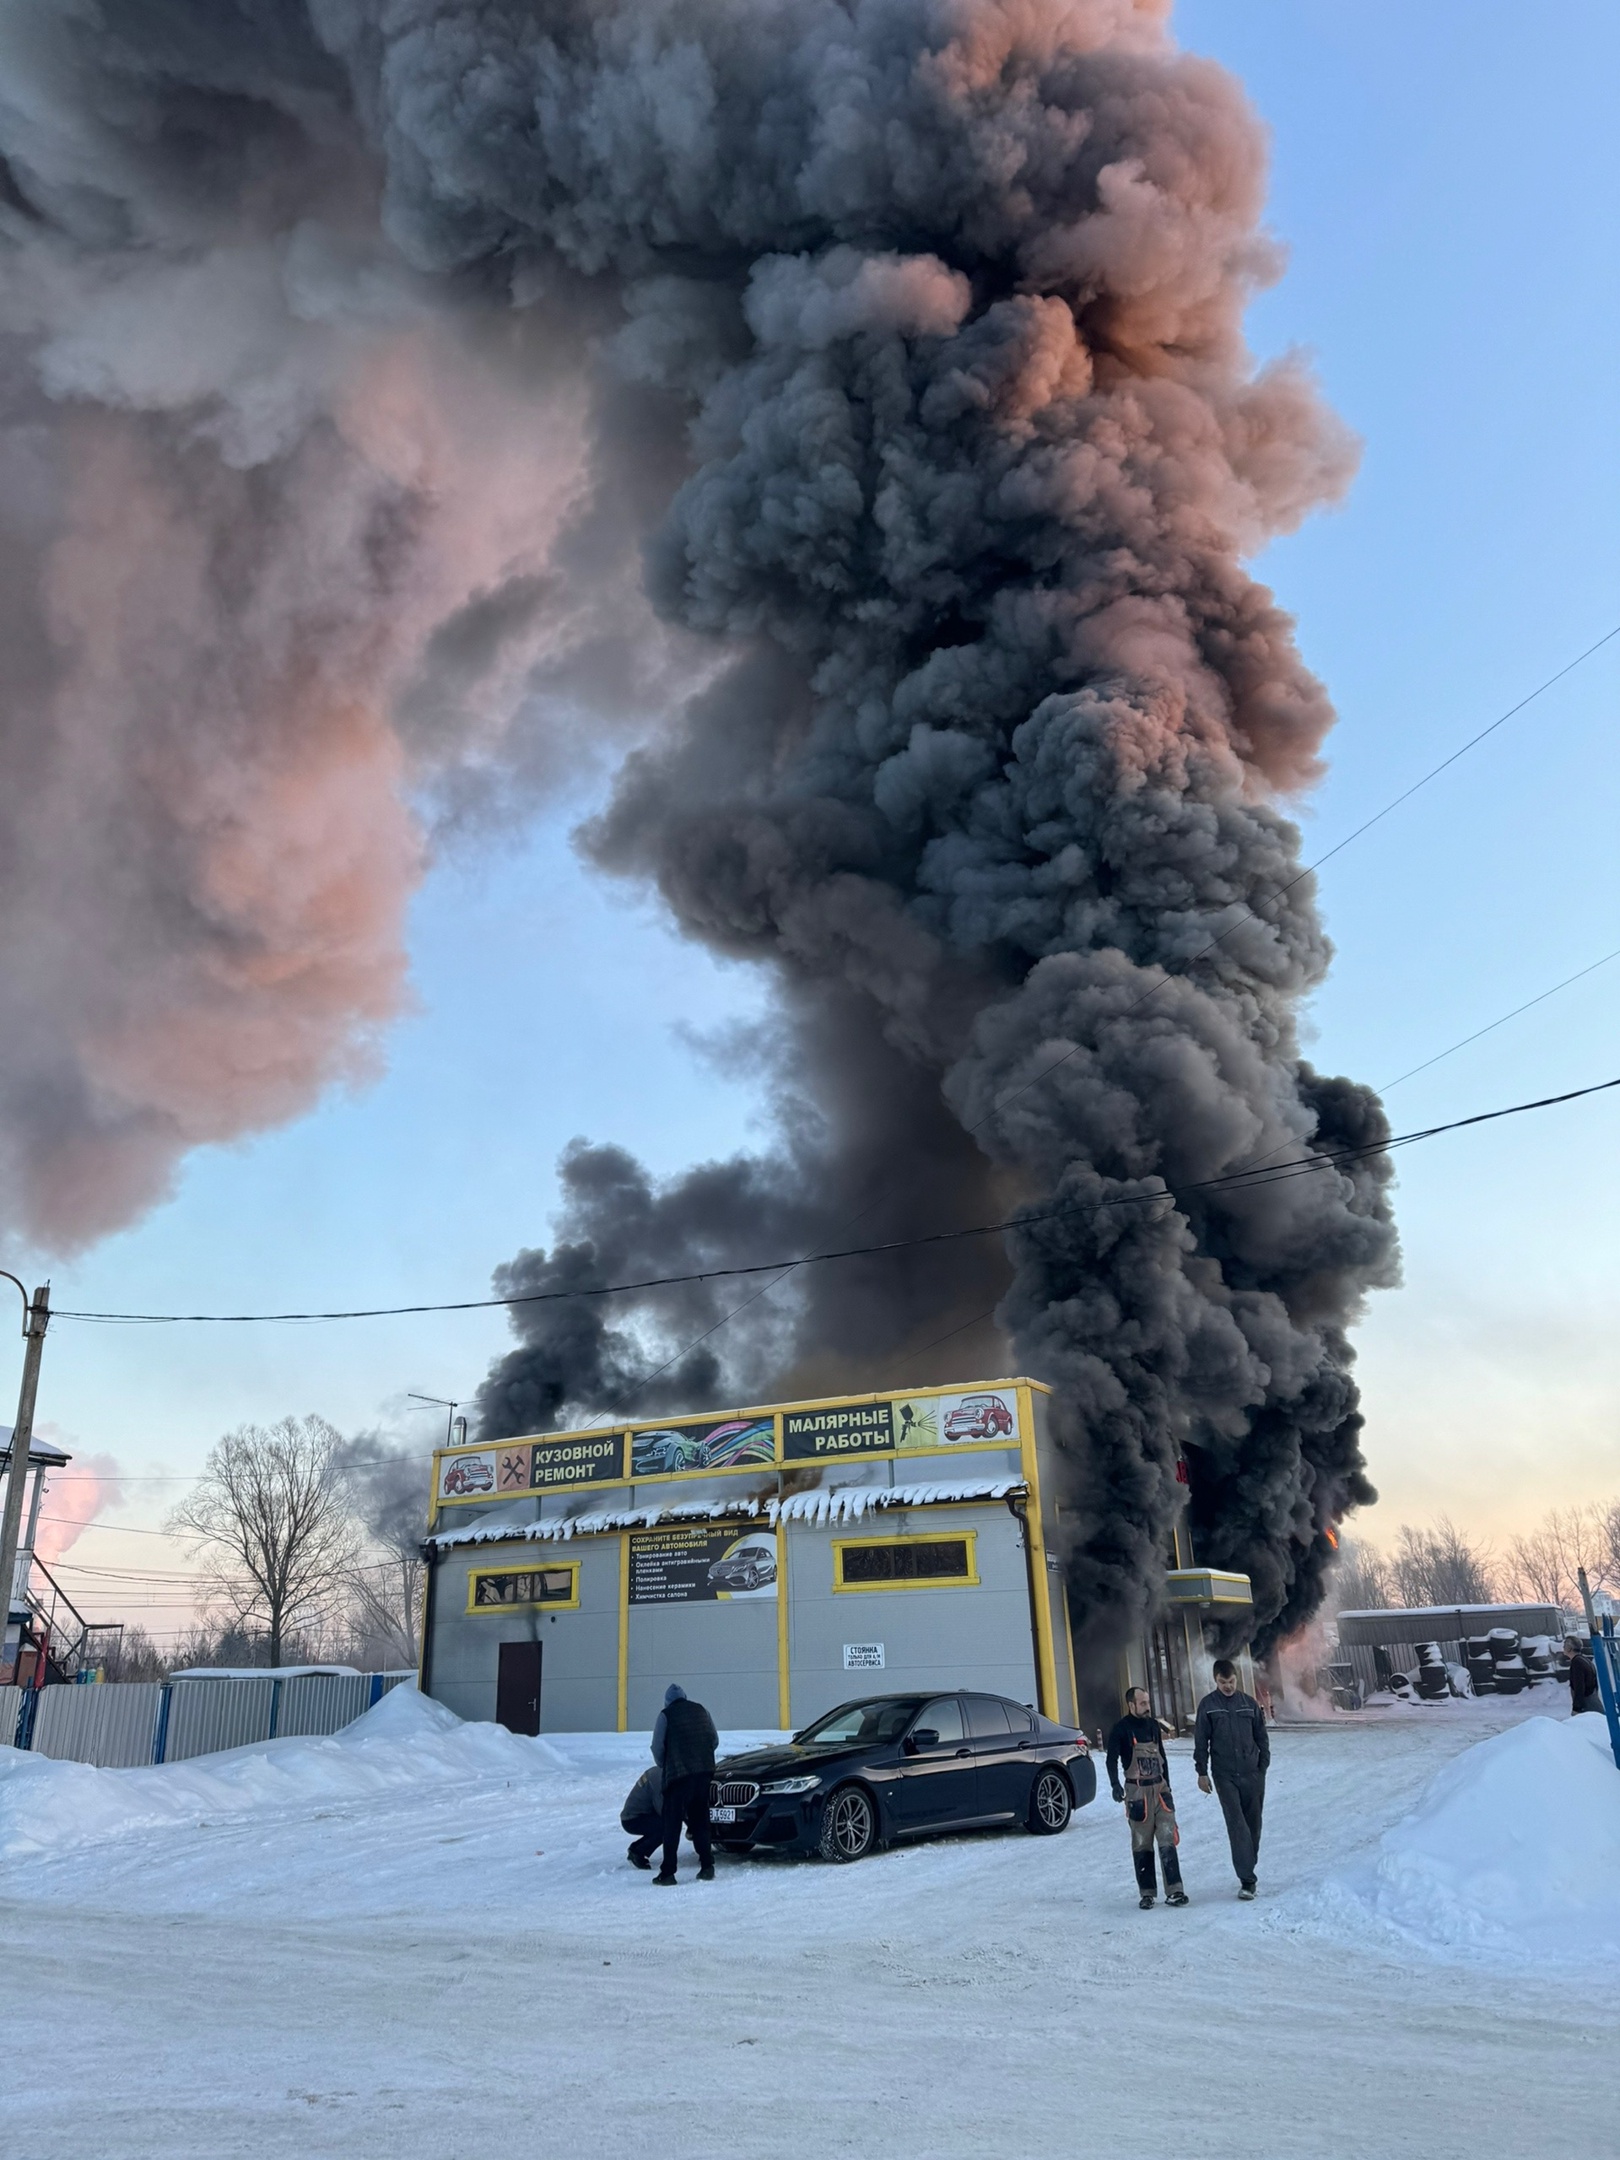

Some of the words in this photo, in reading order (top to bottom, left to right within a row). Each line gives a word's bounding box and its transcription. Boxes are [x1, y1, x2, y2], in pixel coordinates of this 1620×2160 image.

[788, 1409, 890, 1434] МАЛЯРНЫЕ
[814, 1430, 890, 1451] РАБОТЫ
[535, 1440, 615, 1465] КУЗОВНОЙ
[534, 1463, 596, 1484] РЕМОНТ
[632, 1535, 671, 1543] СОХРАНИТЕ
[723, 1529, 739, 1537] ВИД
[661, 1541, 708, 1550] АВТОМОБИЛЯ
[635, 1560, 660, 1568] Оклейка
[635, 1567, 664, 1575] пленками
[635, 1575, 668, 1583] Полировка
[635, 1584, 667, 1592] Нанесение
[667, 1582, 696, 1590] керамики
[635, 1592, 666, 1600] Химчистка
